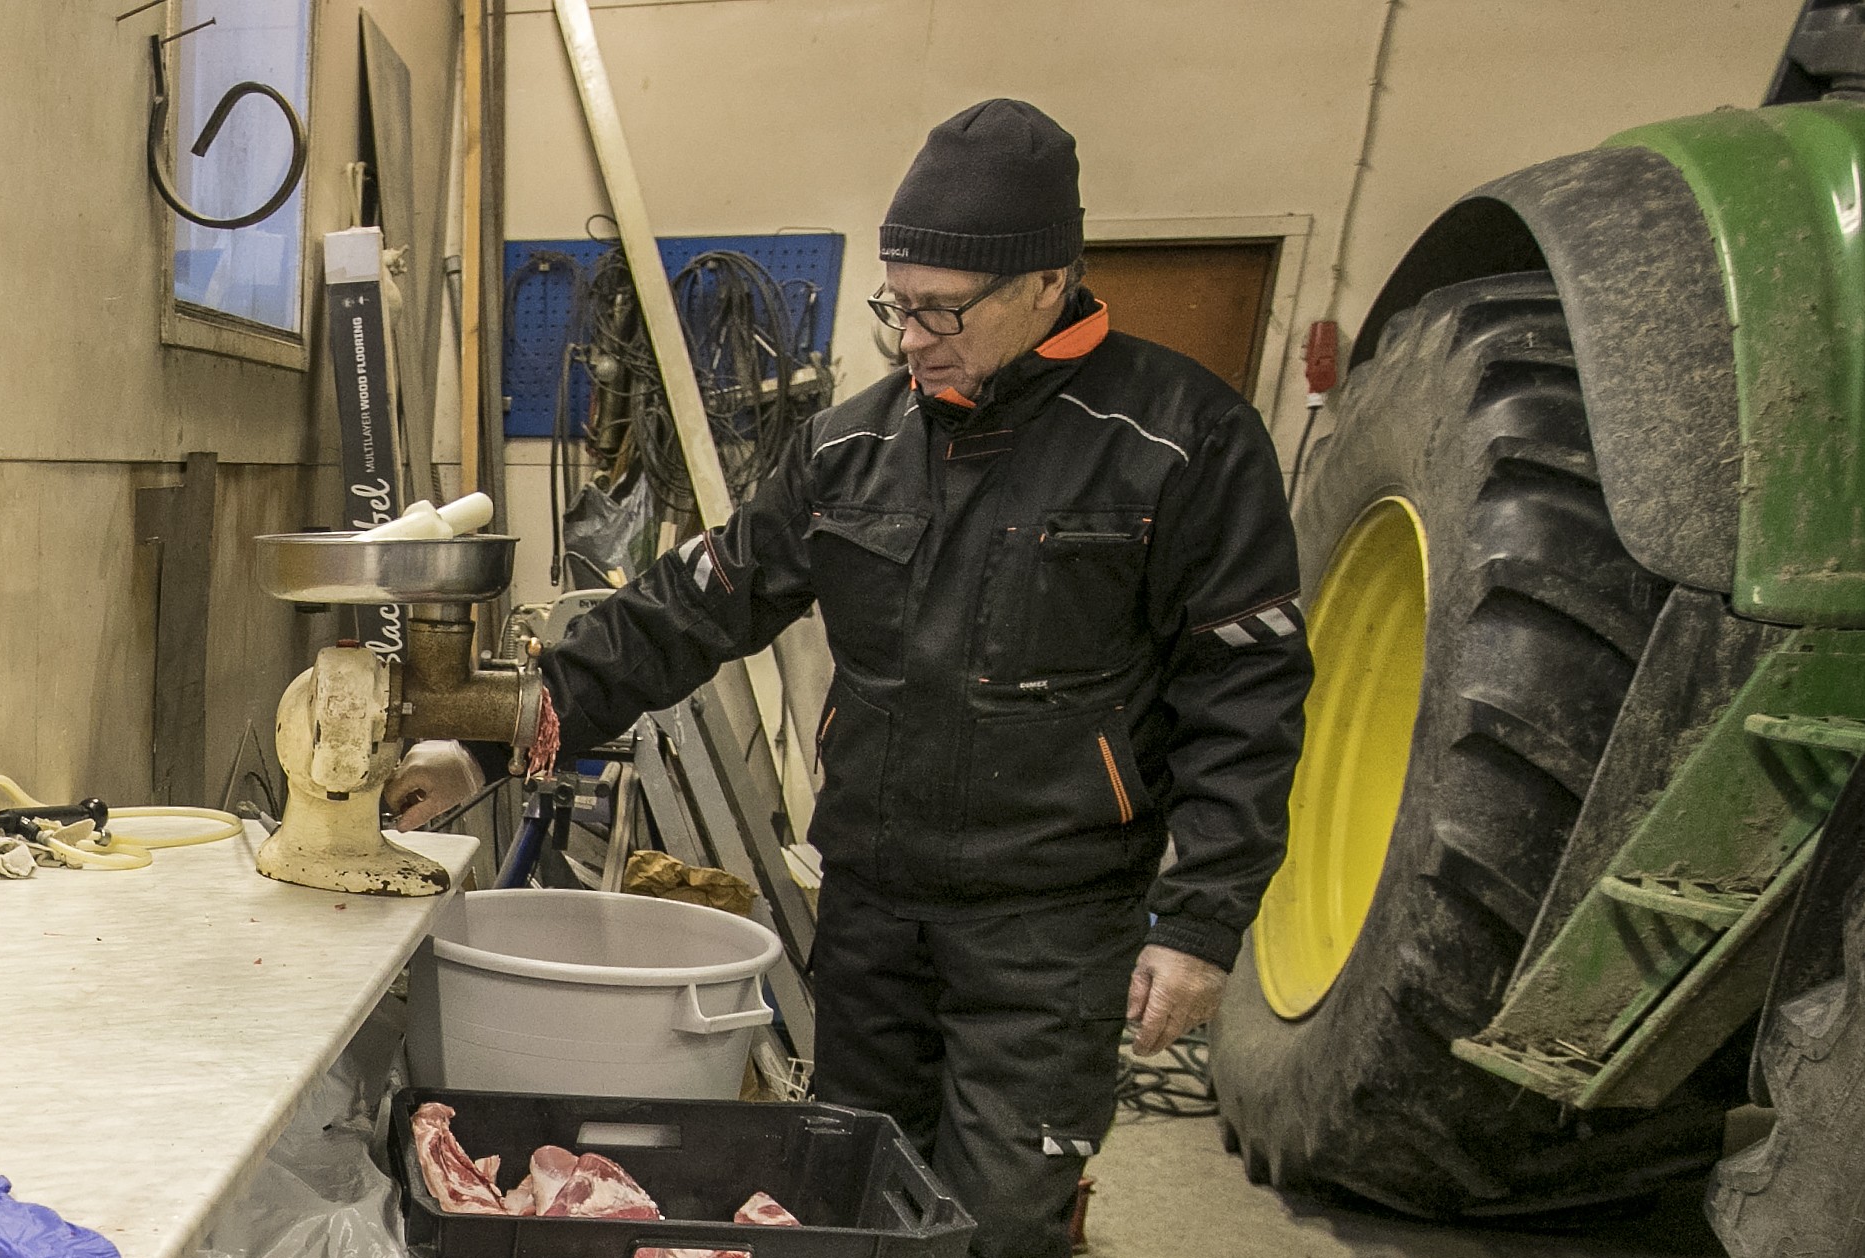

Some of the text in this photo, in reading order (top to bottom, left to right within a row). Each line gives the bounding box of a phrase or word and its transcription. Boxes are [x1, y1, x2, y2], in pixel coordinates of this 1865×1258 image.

[352, 317, 375, 473] MULTILAYER WOOD FLOORING
[351, 478, 392, 530] bel
